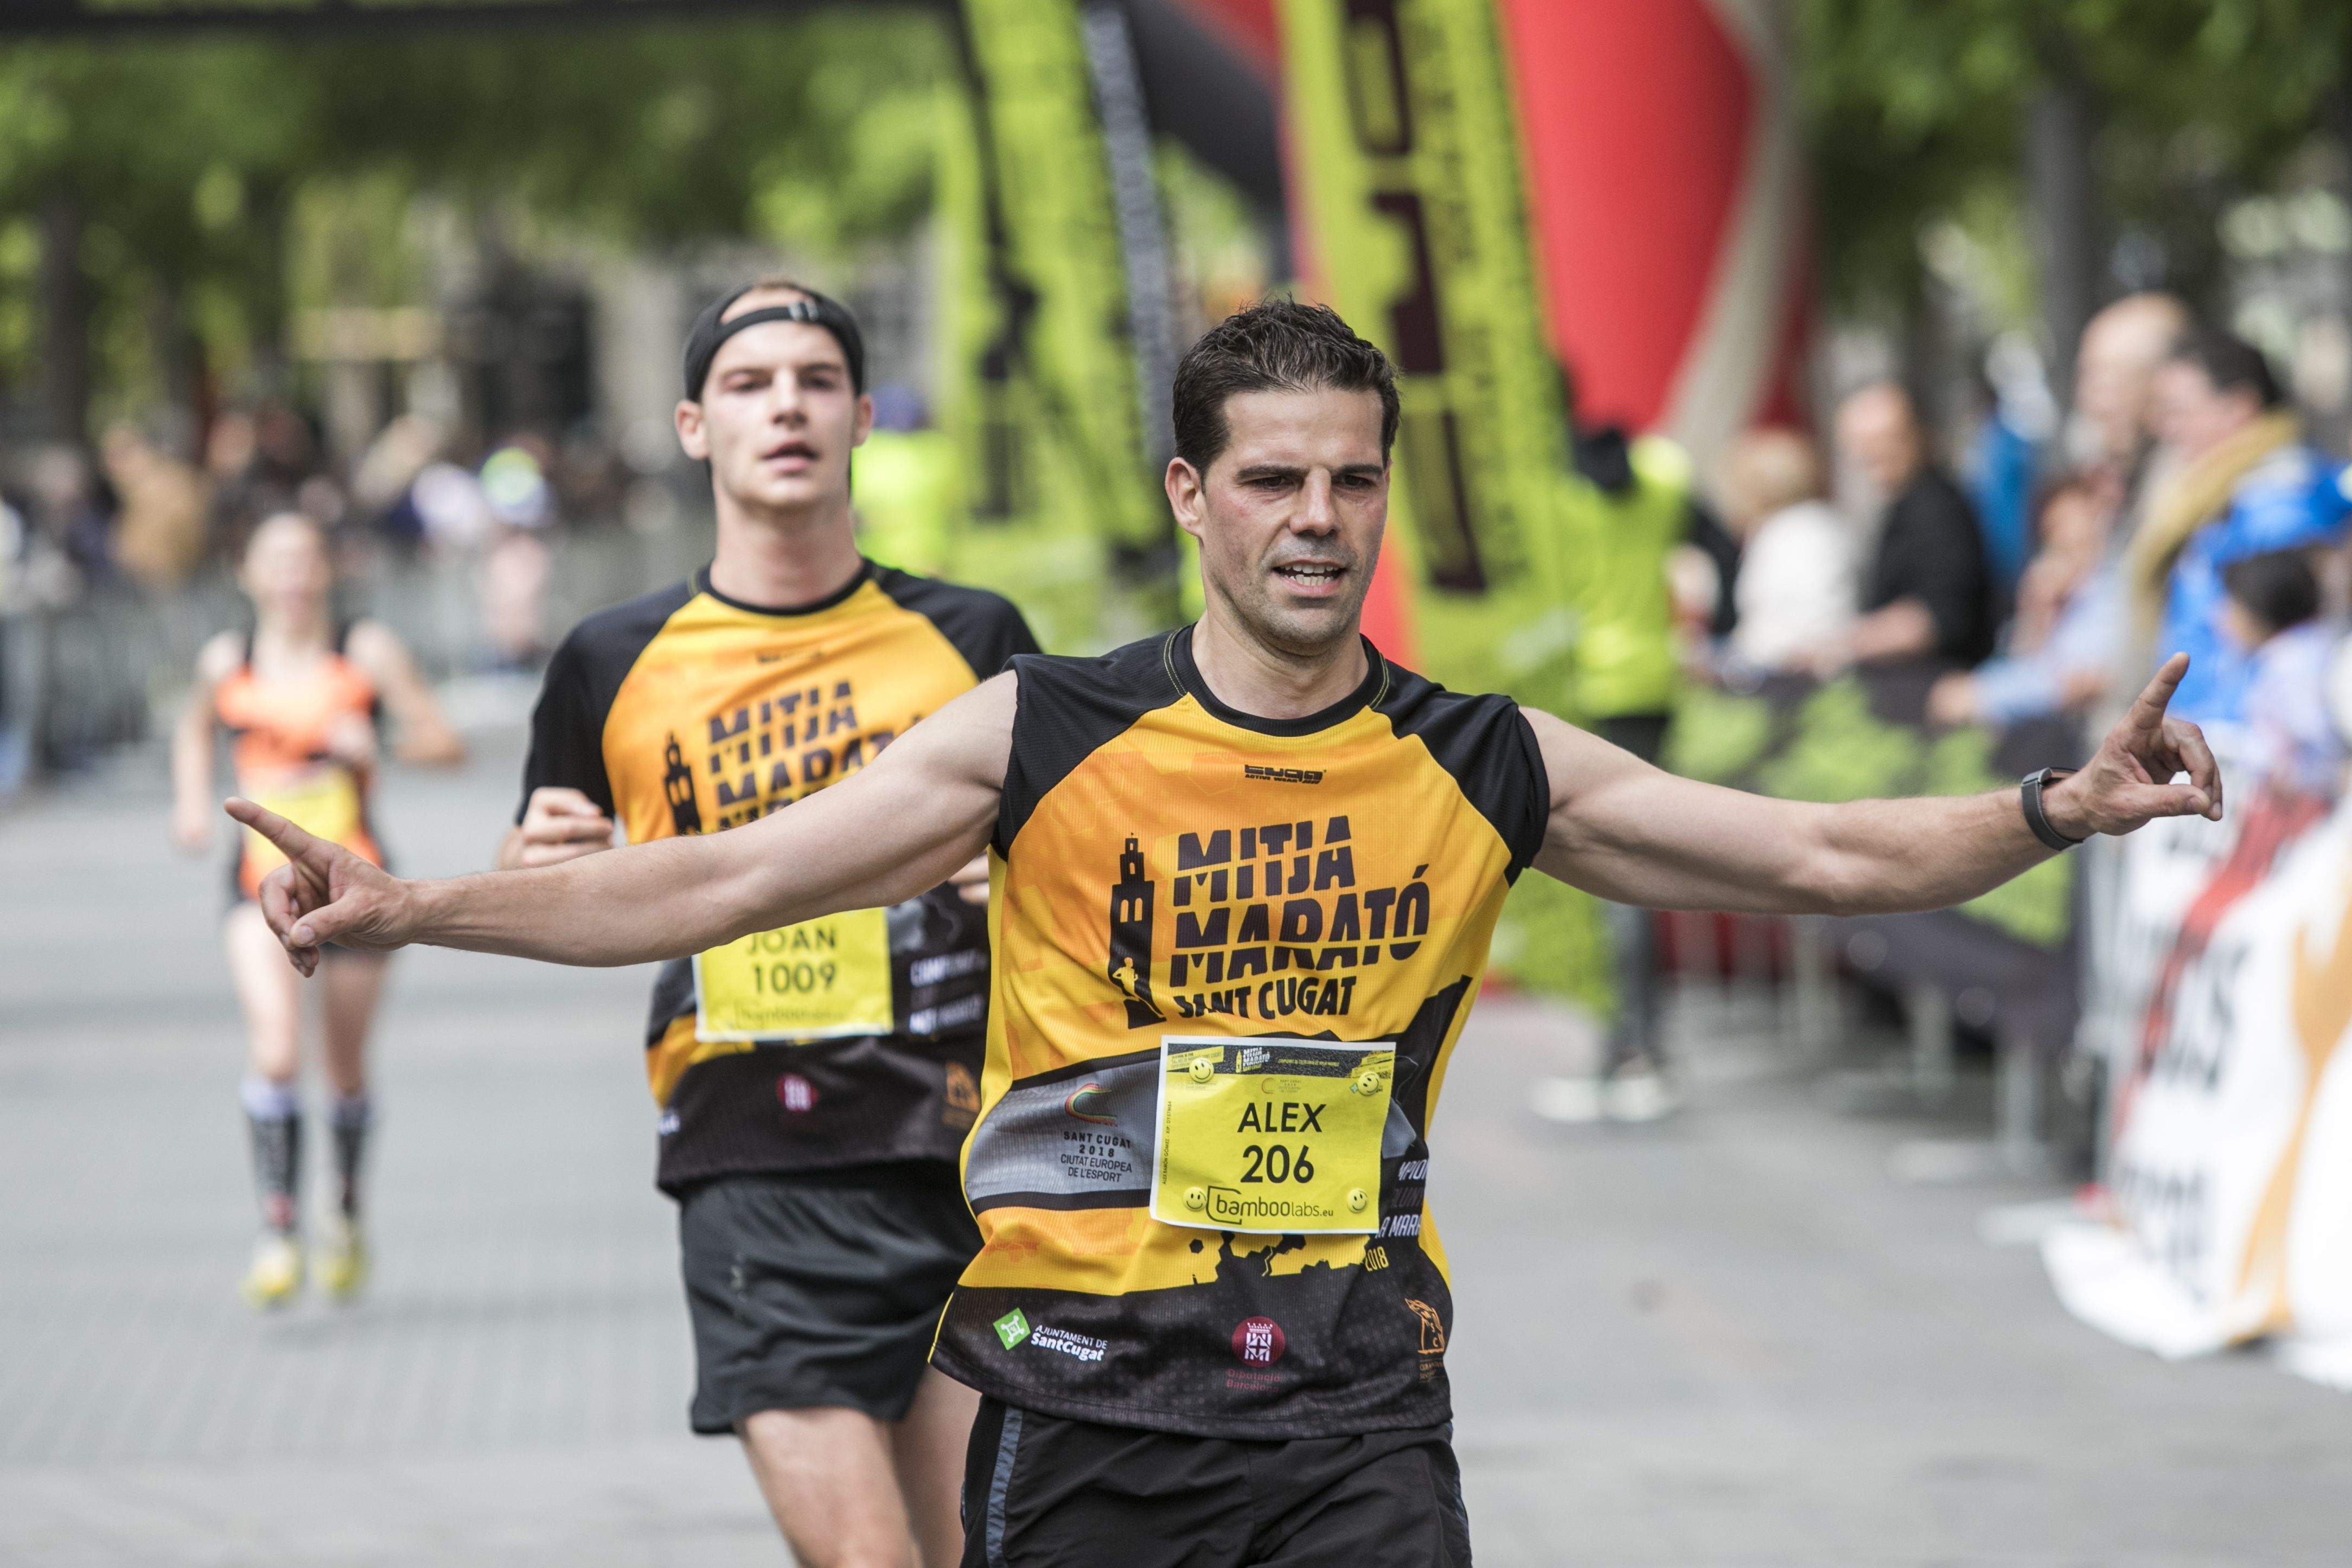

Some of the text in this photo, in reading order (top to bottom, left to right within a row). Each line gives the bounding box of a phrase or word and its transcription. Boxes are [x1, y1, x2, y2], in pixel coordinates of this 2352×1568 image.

[710, 681, 858, 775] MITJA
[1173, 815, 1356, 907] MITJA
[1169, 863, 1430, 987] MARATÓ
[746, 927, 836, 956] JOAN
[753, 961, 837, 994] 1009
[1173, 976, 1357, 1019] SANT CUGAT
[1237, 1102, 1326, 1133] ALEX
[1064, 1131, 1131, 1149] SANT CUGAT
[1060, 1154, 1132, 1173] CIUTAT EUROPEA
[1068, 1167, 1122, 1182] DE L'ESPORT
[1240, 1144, 1314, 1183] 206
[1216, 1194, 1333, 1217] bamboolabs.eu
[1031, 1332, 1104, 1361] SantCugat
[1035, 1324, 1109, 1349] AJUNTAMENT DE
[1226, 1379, 1279, 1393] Barcelona
